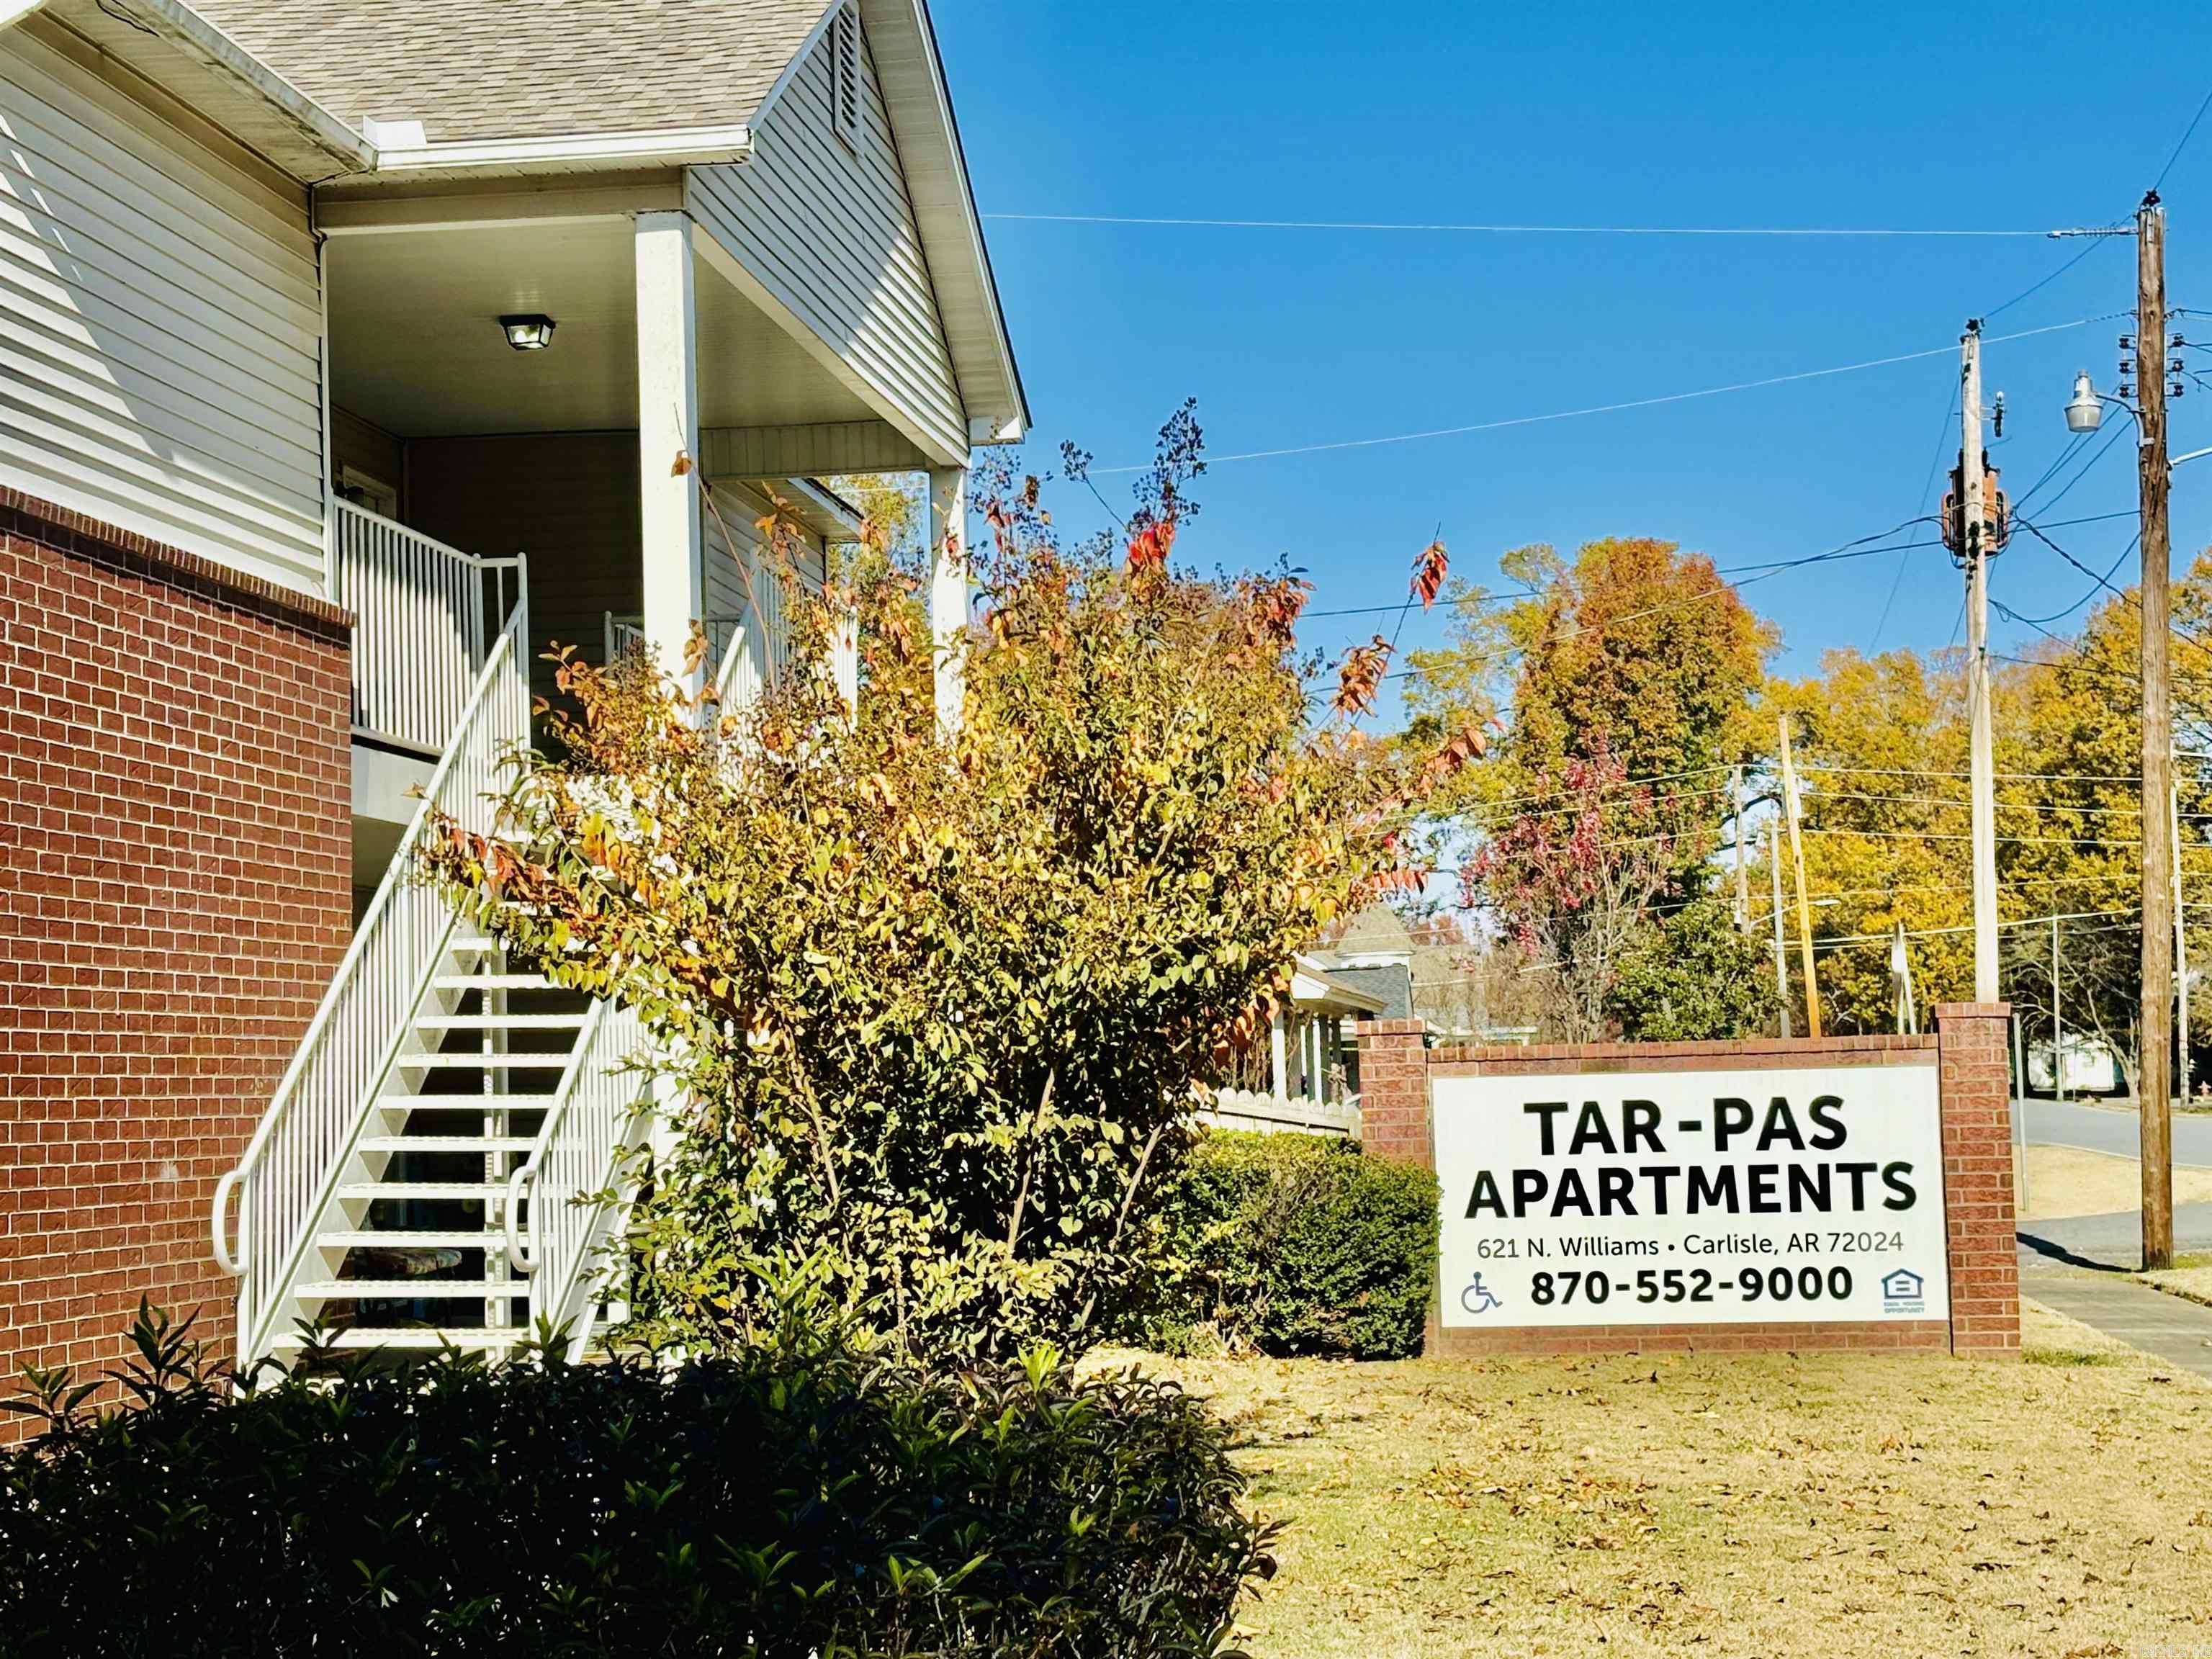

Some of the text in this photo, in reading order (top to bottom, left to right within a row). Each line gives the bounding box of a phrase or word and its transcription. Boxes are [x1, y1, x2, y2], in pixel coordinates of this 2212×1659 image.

[1523, 1094, 1848, 1156] TAR-PAS
[1463, 1161, 1917, 1220] APARTMENTS
[1477, 1231, 1904, 1259] 621 N. Williams Carlisle, AR 72024
[1530, 1265, 1853, 1306] 870-552-9000
